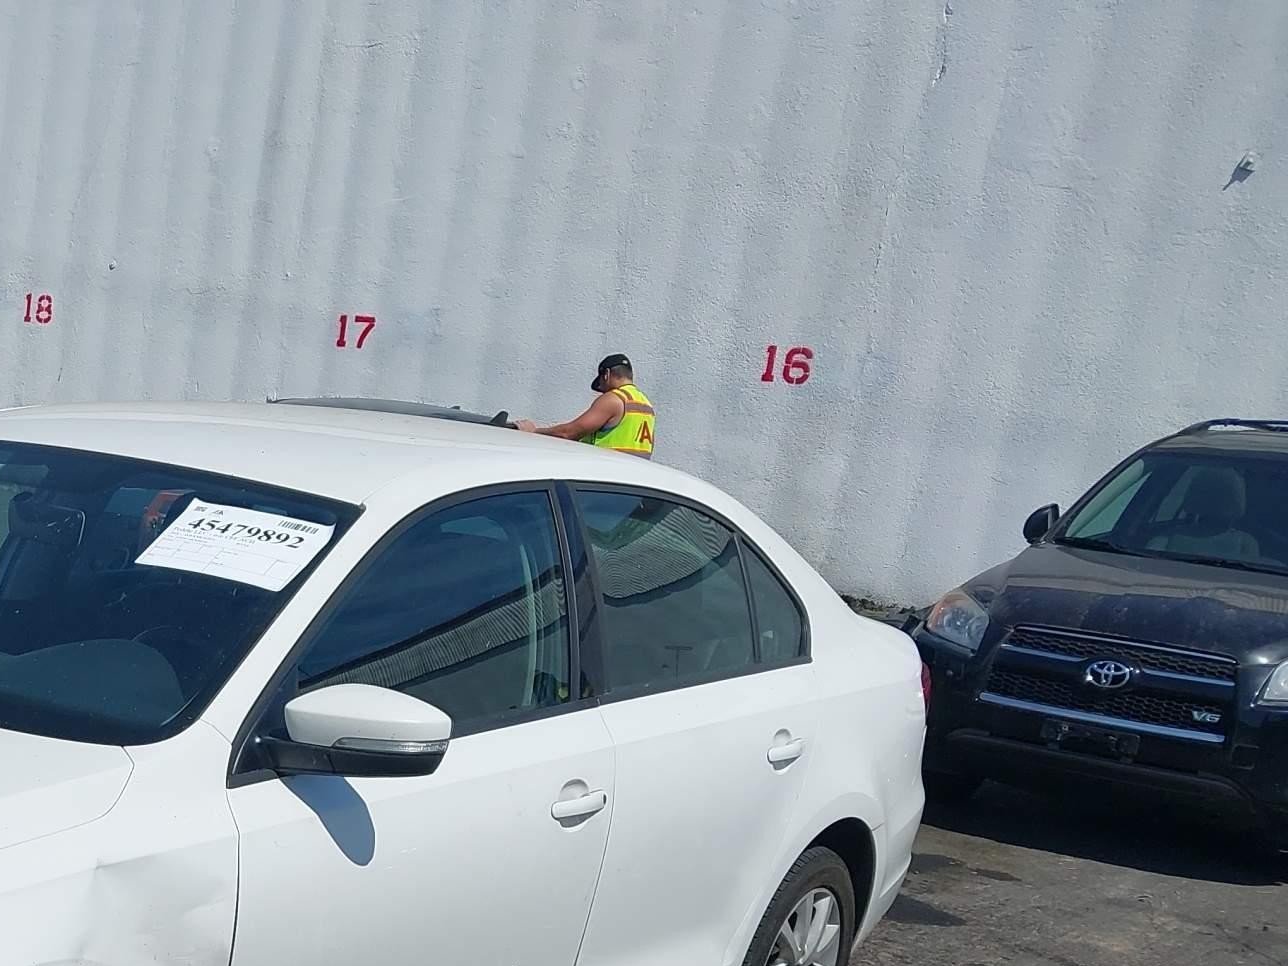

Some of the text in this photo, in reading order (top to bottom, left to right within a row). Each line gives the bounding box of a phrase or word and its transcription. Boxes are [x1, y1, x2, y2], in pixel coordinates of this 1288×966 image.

[23, 293, 53, 324] 18
[336, 315, 377, 348] 17
[761, 345, 813, 385] 16
[188, 517, 305, 549] 45479892
[1192, 710, 1222, 723] V6
